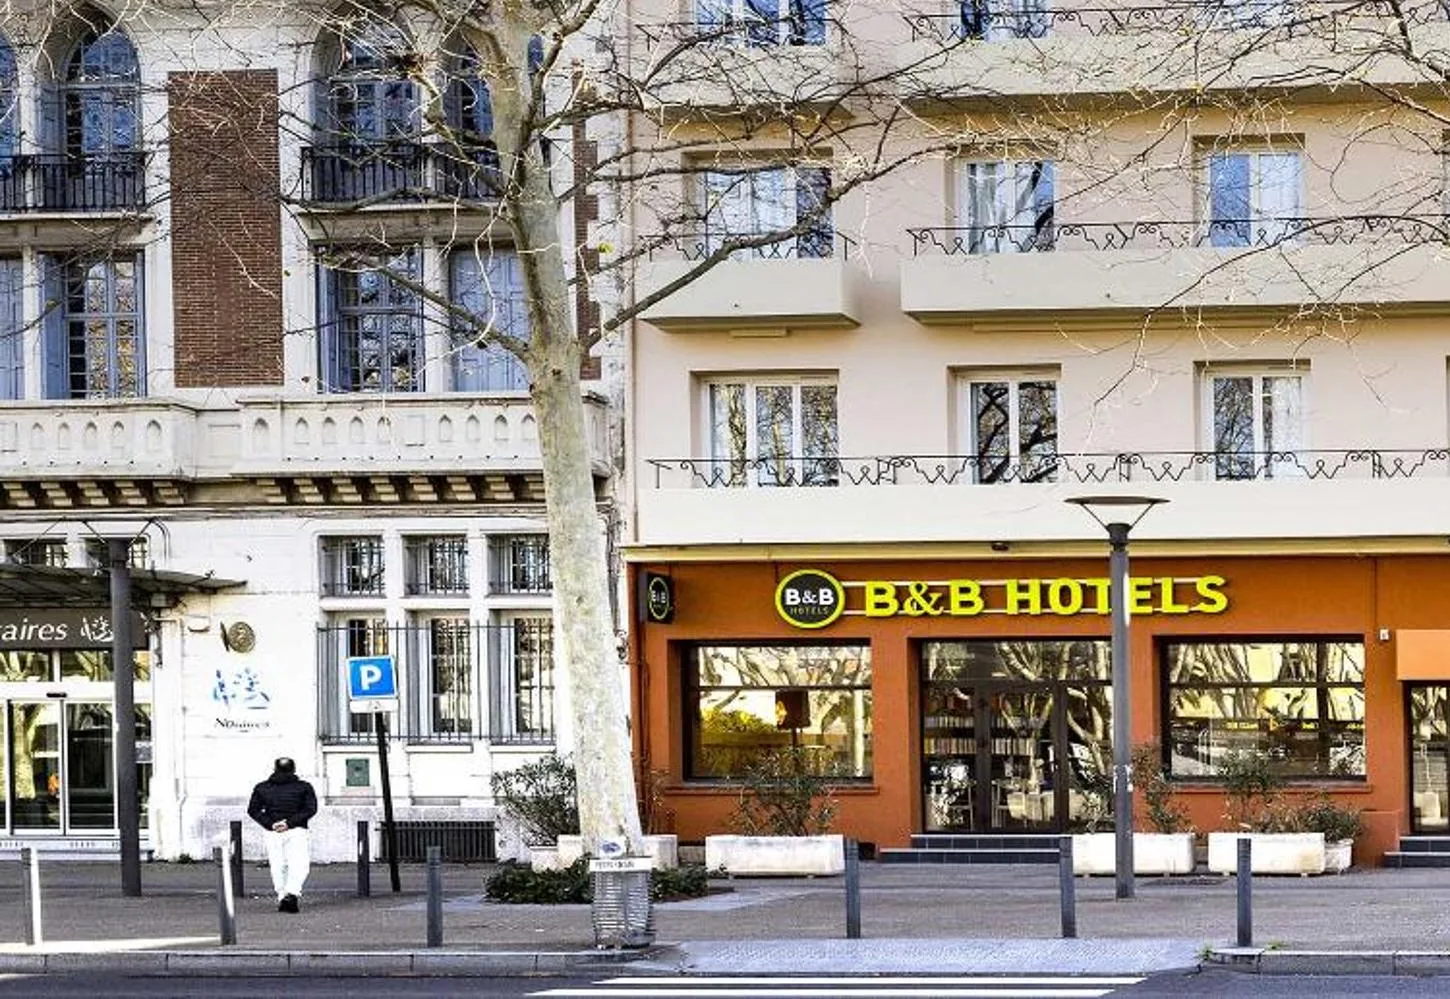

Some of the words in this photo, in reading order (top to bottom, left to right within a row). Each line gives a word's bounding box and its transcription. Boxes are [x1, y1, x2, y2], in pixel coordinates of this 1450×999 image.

[785, 588, 834, 605] B&B
[865, 580, 984, 617] B&B
[1006, 576, 1228, 615] HOTELS
[790, 606, 829, 616] HOTELS
[0, 617, 69, 641] aires
[360, 664, 382, 691] P
